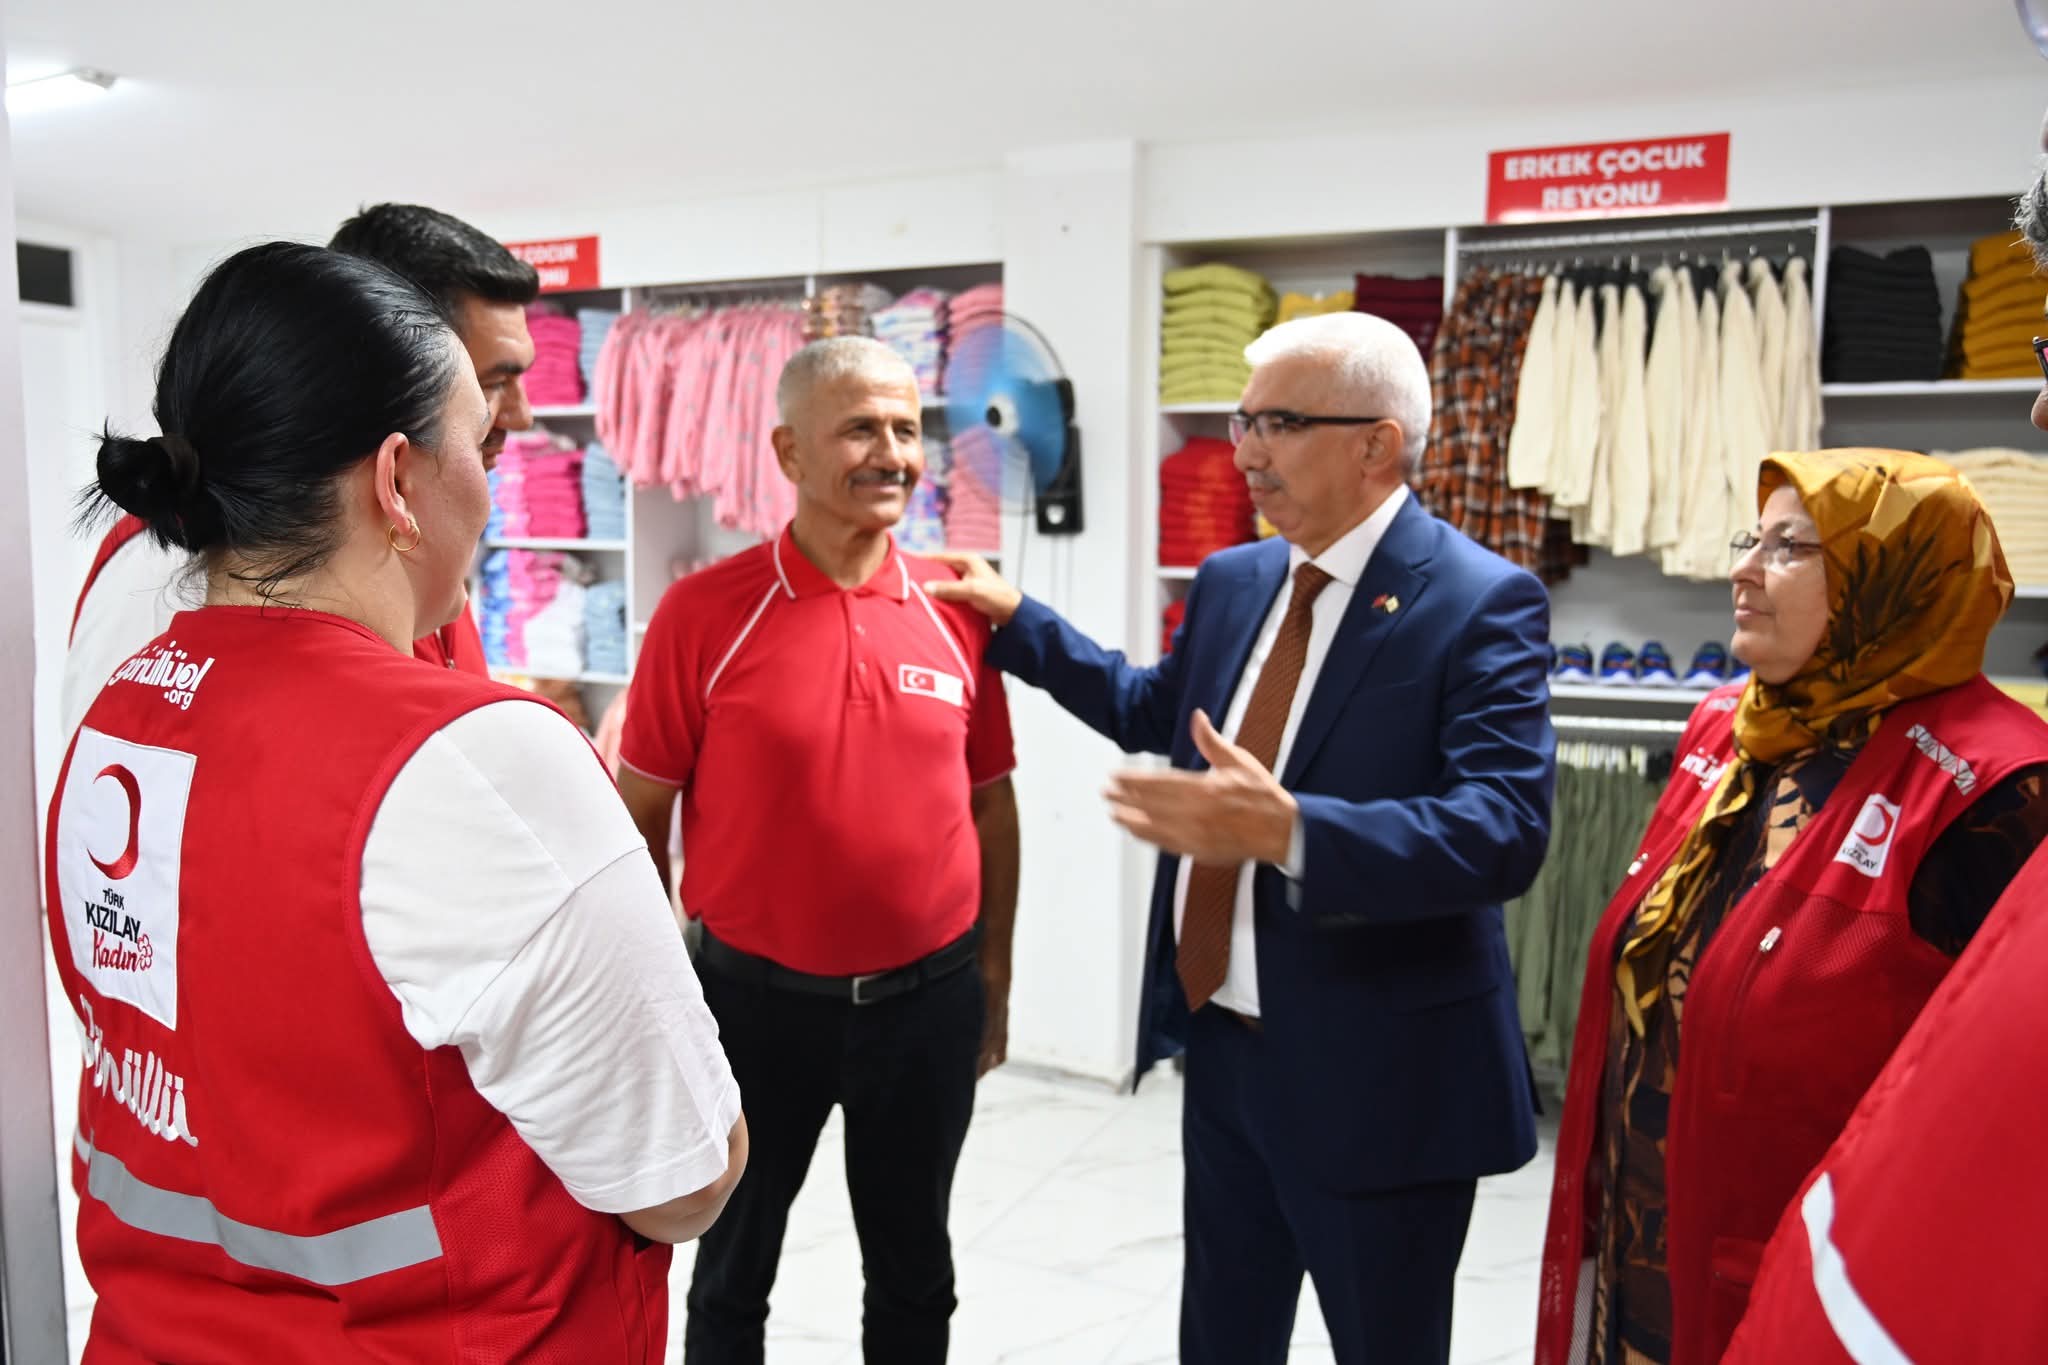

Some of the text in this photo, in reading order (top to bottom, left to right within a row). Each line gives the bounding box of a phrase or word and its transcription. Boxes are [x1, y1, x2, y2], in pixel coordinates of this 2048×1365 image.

[1504, 143, 1705, 180] ERKEK ÇOCUK
[1541, 180, 1661, 210] REYONU
[163, 690, 194, 711] .org
[102, 887, 125, 911] TÜRK
[85, 900, 141, 944] KIZILAY
[92, 927, 140, 973] Kadın
